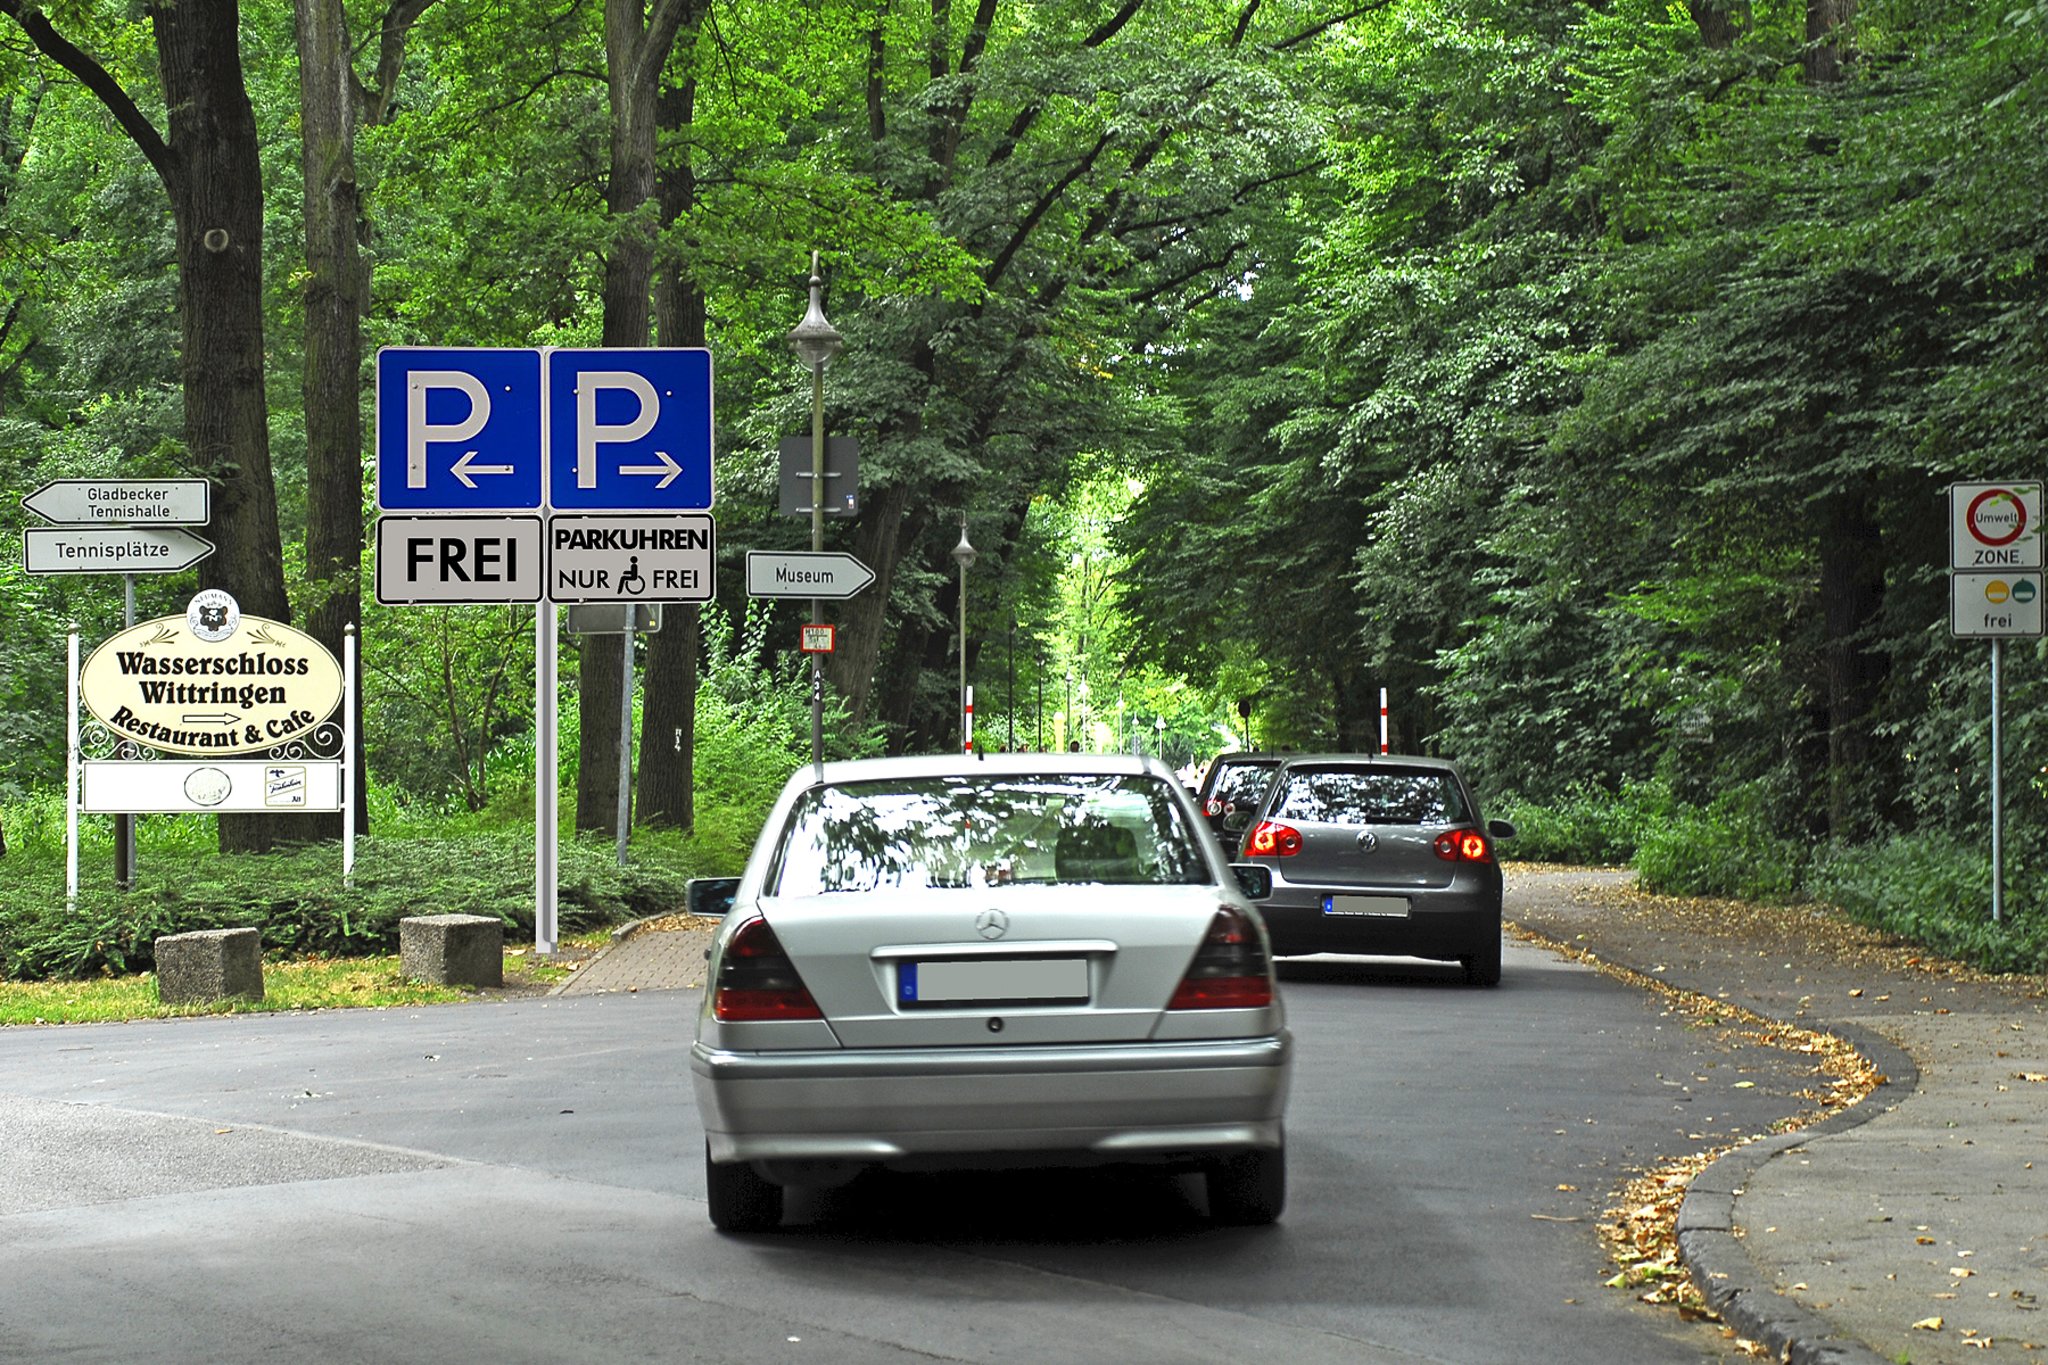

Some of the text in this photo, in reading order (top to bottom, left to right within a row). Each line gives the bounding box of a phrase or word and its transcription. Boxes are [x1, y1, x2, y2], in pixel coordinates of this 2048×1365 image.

[407, 370, 491, 489] P
[577, 371, 660, 489] P
[87, 487, 169, 501] Gladbecker
[88, 504, 170, 518] Tennishalle
[1975, 512, 2019, 524] Umwelt
[555, 529, 708, 550] PARKUHREN
[55, 541, 169, 561] Tennisplätze
[407, 537, 517, 582] FREI
[1974, 550, 2020, 565] ZONE
[559, 569, 699, 589] NUR FREI
[775, 567, 834, 583] Museum
[1984, 613, 2012, 628] frei
[116, 651, 309, 675] Wasserschloss
[139, 681, 287, 709] Wittringen
[110, 706, 315, 747] Restaurant & Cafe
